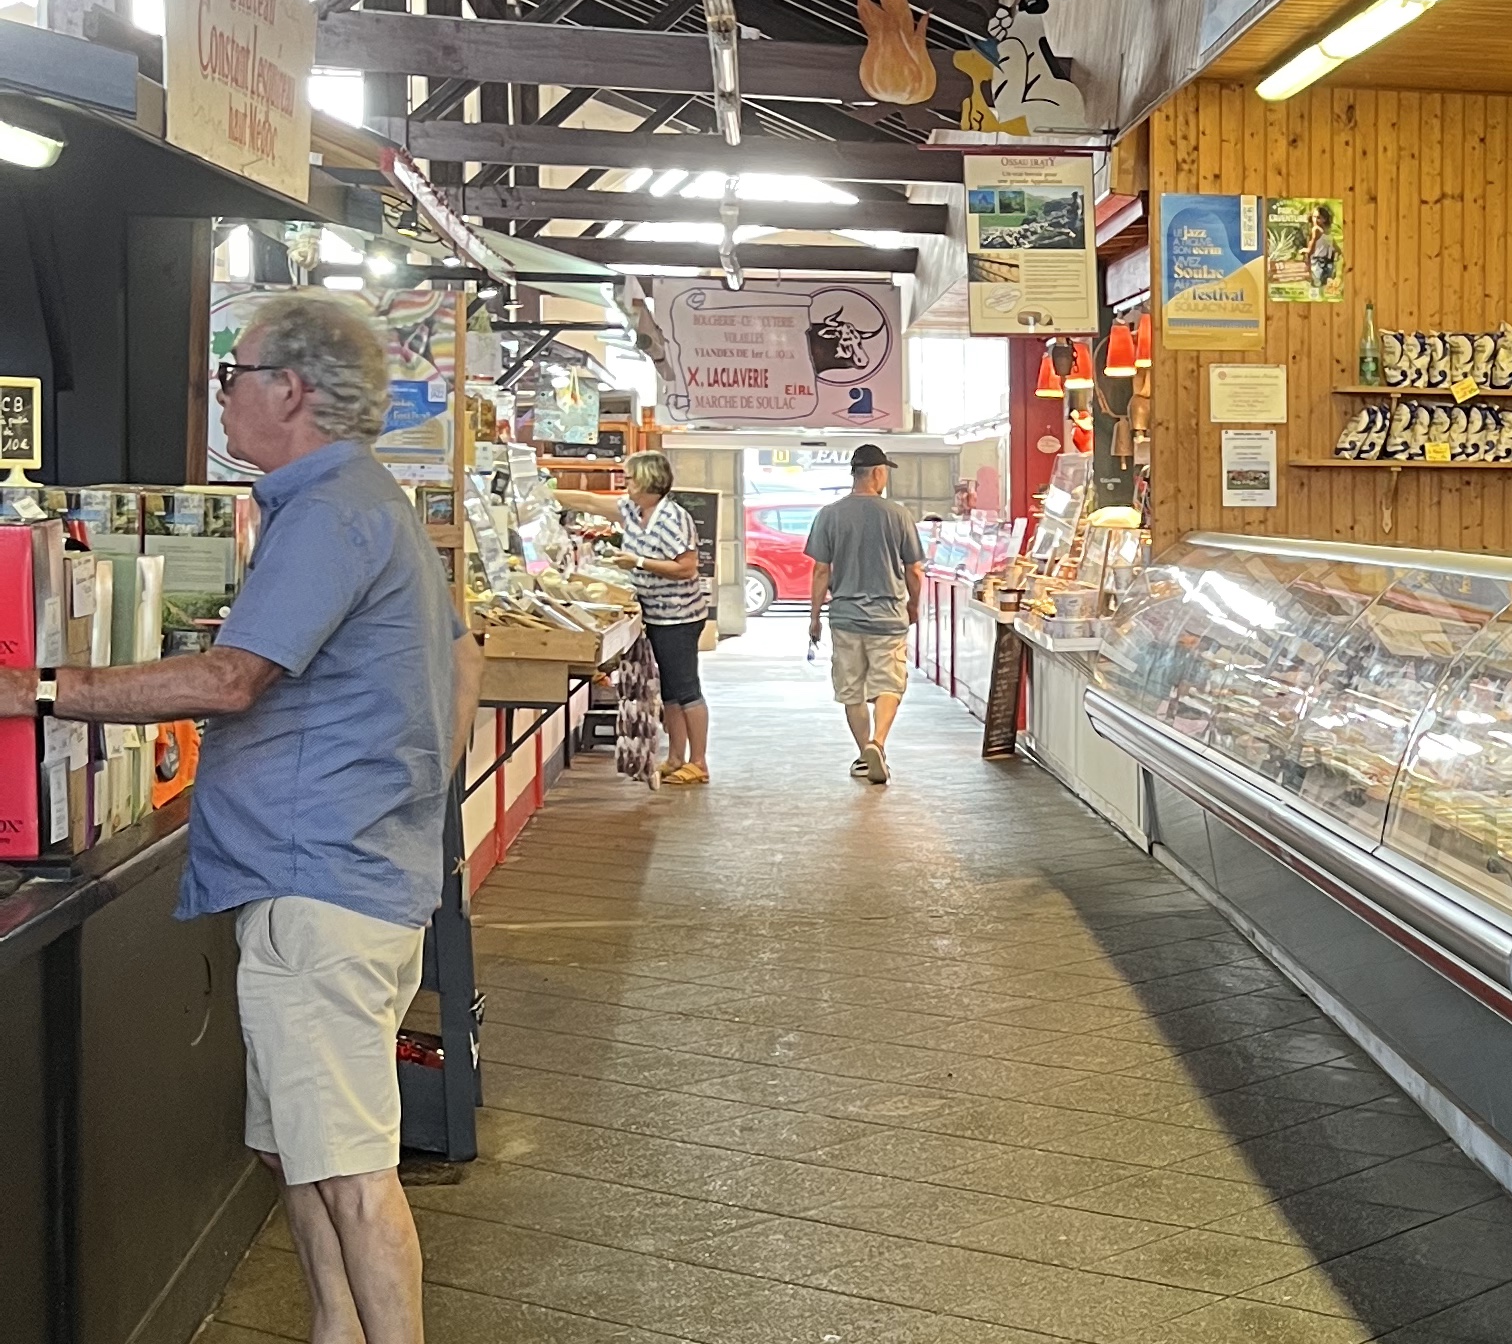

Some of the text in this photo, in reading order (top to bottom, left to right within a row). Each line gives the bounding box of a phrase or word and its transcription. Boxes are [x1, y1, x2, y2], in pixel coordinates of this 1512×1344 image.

[1173, 263, 1224, 279] Soulac
[736, 348, 749, 358] DE
[707, 367, 769, 389] LACLAVERIE
[740, 396, 754, 409] DE
[756, 397, 796, 410] SOULAC
